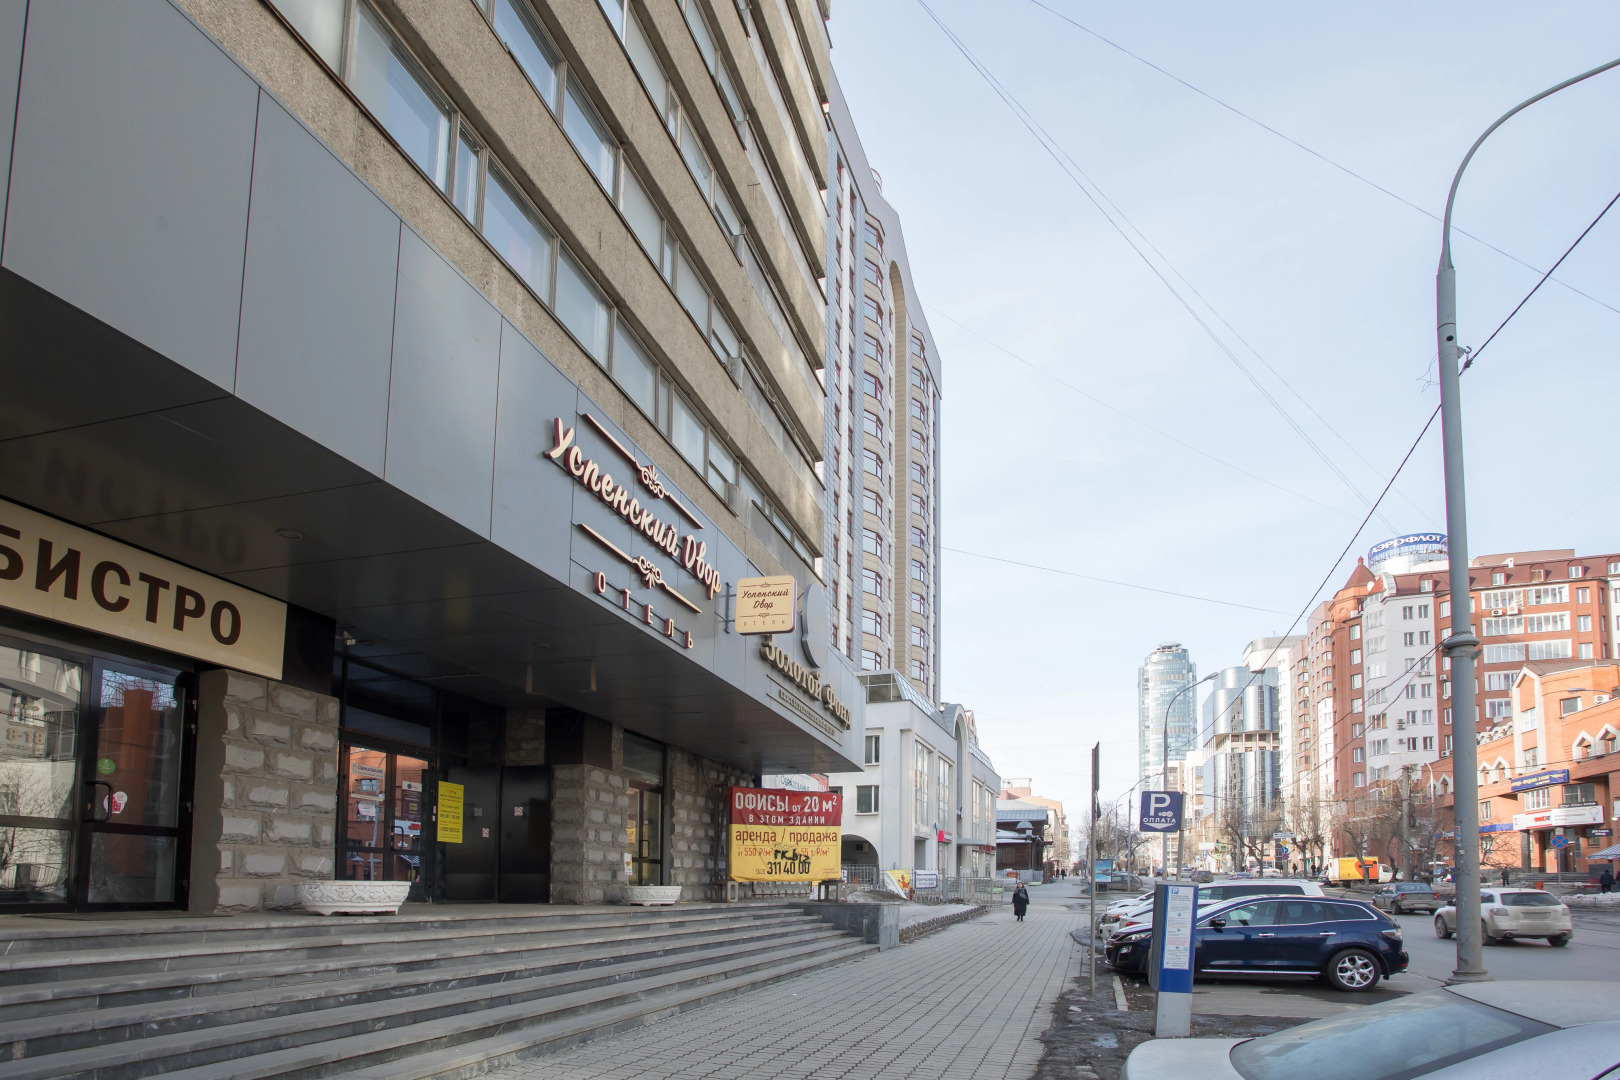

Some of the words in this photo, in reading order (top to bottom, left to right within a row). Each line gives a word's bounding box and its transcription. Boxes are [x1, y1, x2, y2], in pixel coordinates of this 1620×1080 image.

[544, 417, 680, 557] Успенский
[681, 534, 722, 600] Двор
[1371, 534, 1441, 555] АЭРОФЛОТ
[741, 588, 790, 599] Успенский
[752, 598, 774, 610] Двор
[735, 792, 789, 812] ОФИСЫ
[792, 805, 801, 813] от
[803, 796, 819, 813] 20
[748, 814, 754, 823] В
[759, 814, 784, 824] ЭТОМ
[789, 816, 825, 826] ЗДАНИИ
[735, 830, 777, 844] аренда
[789, 831, 838, 845] продажа
[744, 847, 757, 857] 550
[766, 861, 781, 875] 311
[783, 861, 796, 875] 40
[798, 861, 811, 875] 00
